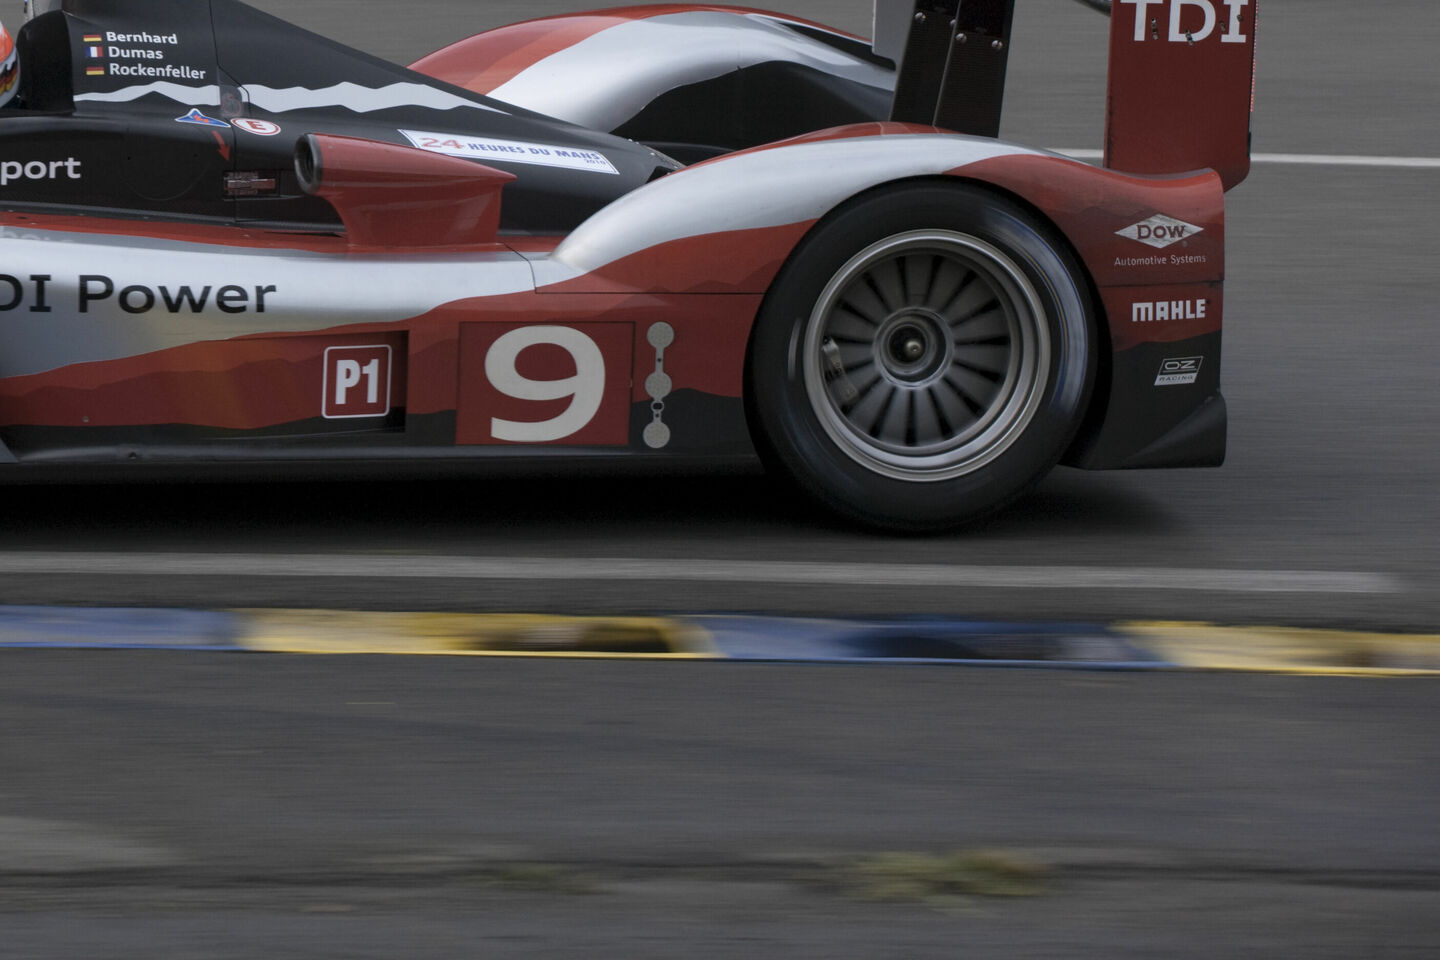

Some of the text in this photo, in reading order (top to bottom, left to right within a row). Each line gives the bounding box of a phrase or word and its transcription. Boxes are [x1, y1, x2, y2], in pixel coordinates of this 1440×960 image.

[105, 31, 178, 45] Bernhard
[108, 46, 164, 59] Dumas
[109, 63, 206, 79] Rockenfeller
[421, 137, 601, 161] 24 HEURES DU MANS
[1114, 254, 1207, 266] Automotive Systems
[78, 274, 277, 314] Power
[1132, 298, 1206, 322] MAHLE
[335, 358, 380, 405] P1
[484, 324, 606, 442] 9
[1159, 374, 1194, 382] RACING
